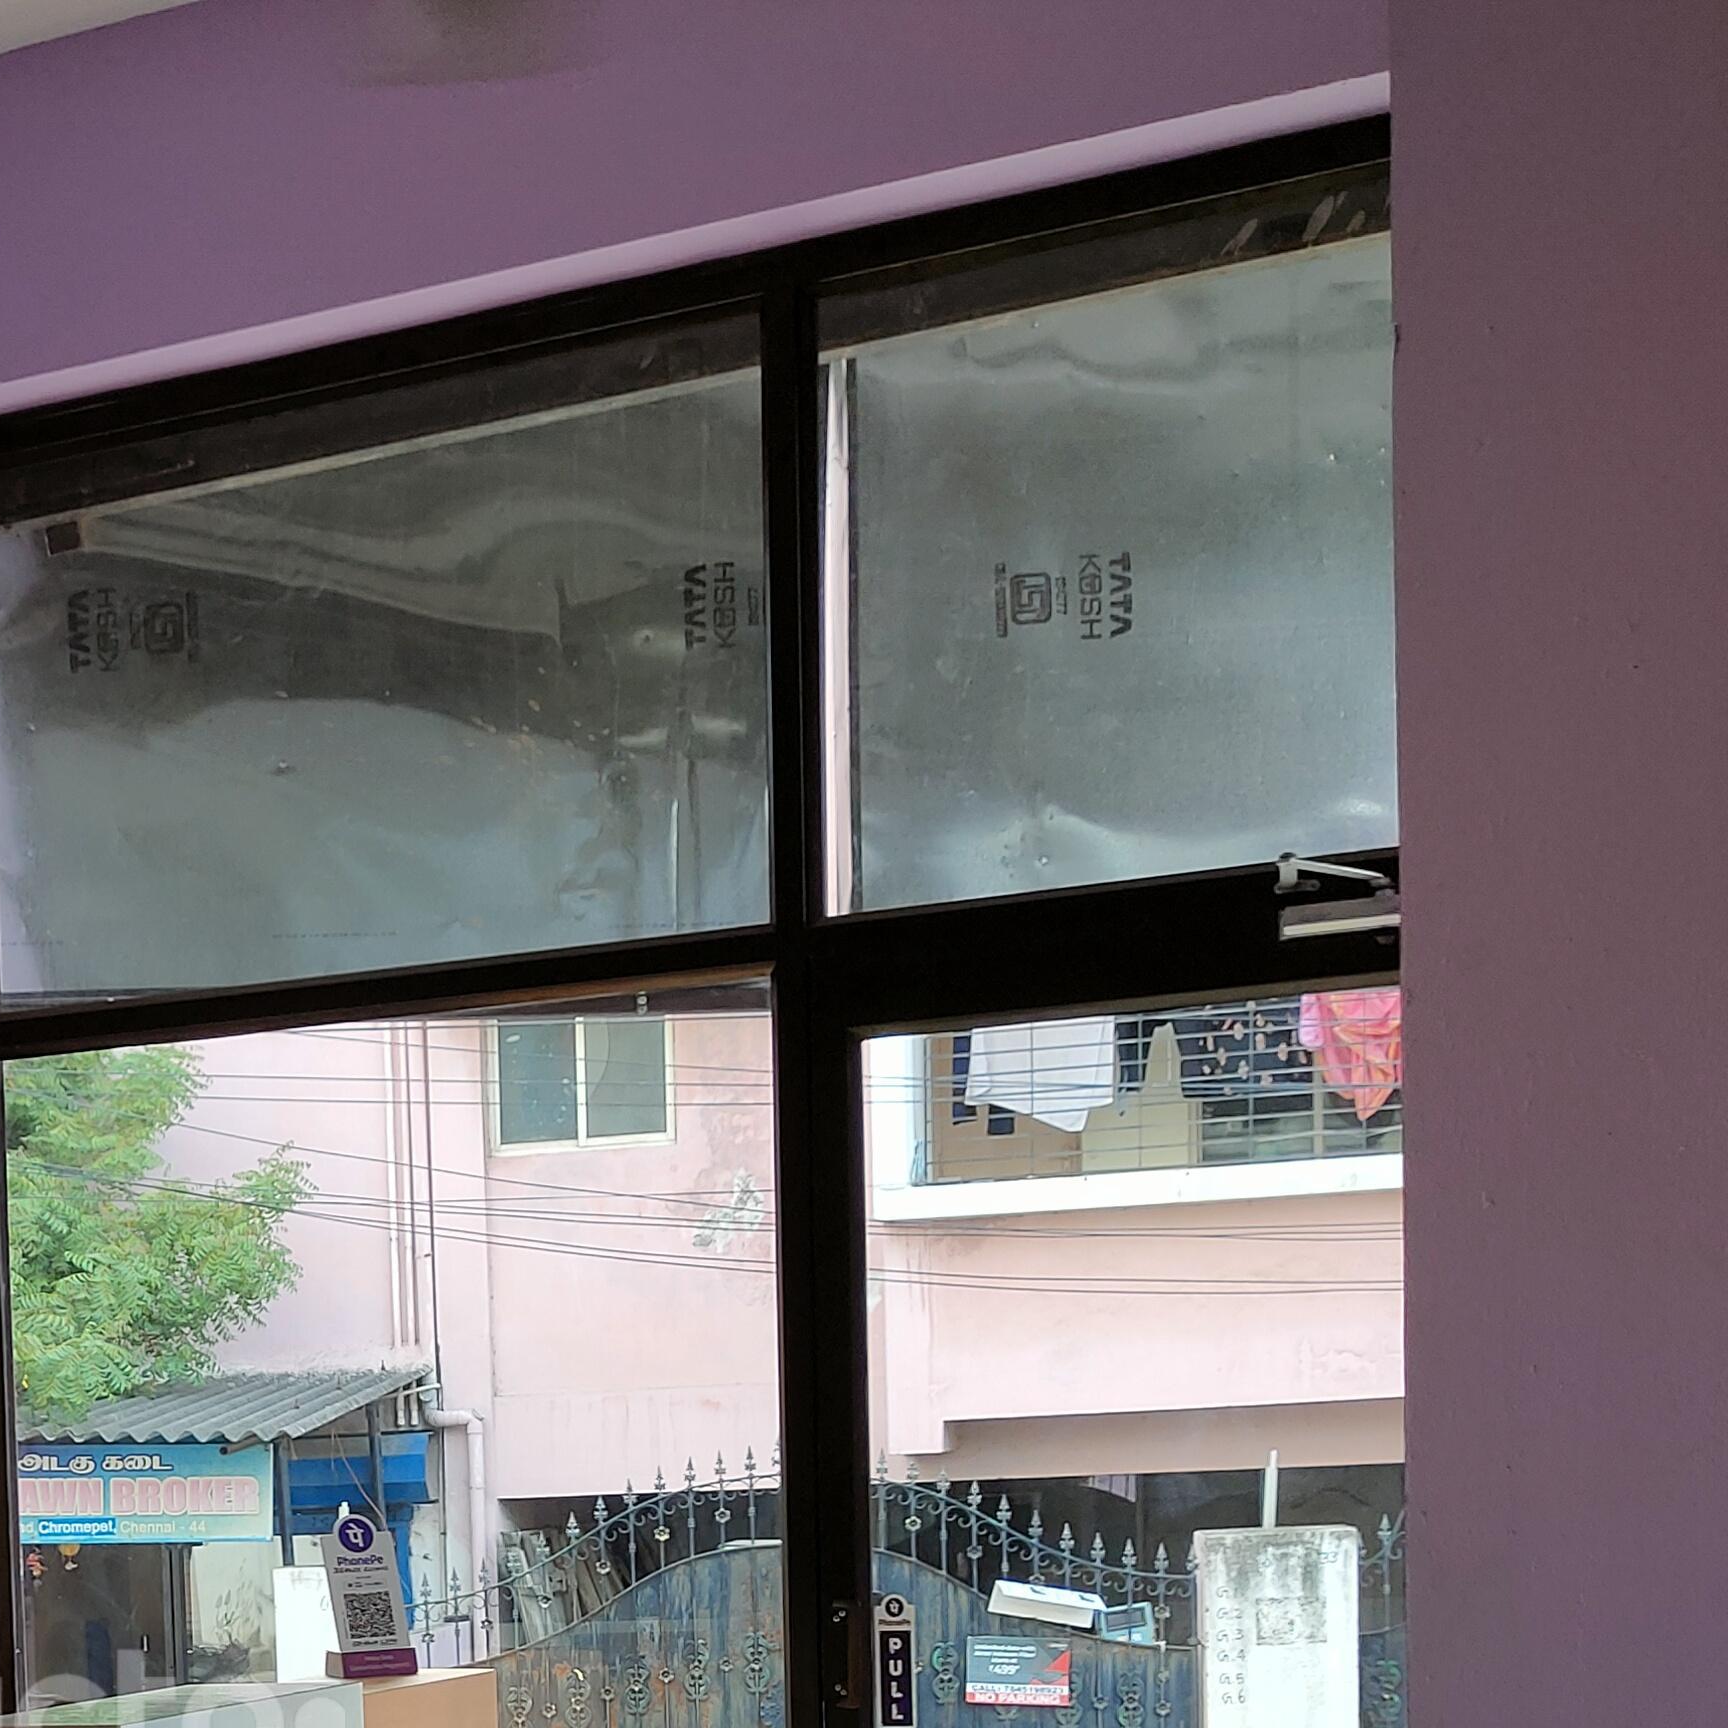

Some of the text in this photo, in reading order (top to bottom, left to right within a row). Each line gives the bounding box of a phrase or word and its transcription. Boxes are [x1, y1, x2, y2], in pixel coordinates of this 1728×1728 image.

[1109, 552, 1133, 639] TATA
[102, 1454, 174, 1471] கடை
[109, 1476, 260, 1516] BROKER
[336, 1554, 384, 1567] PhonePe
[888, 1637, 904, 1720] PULL
